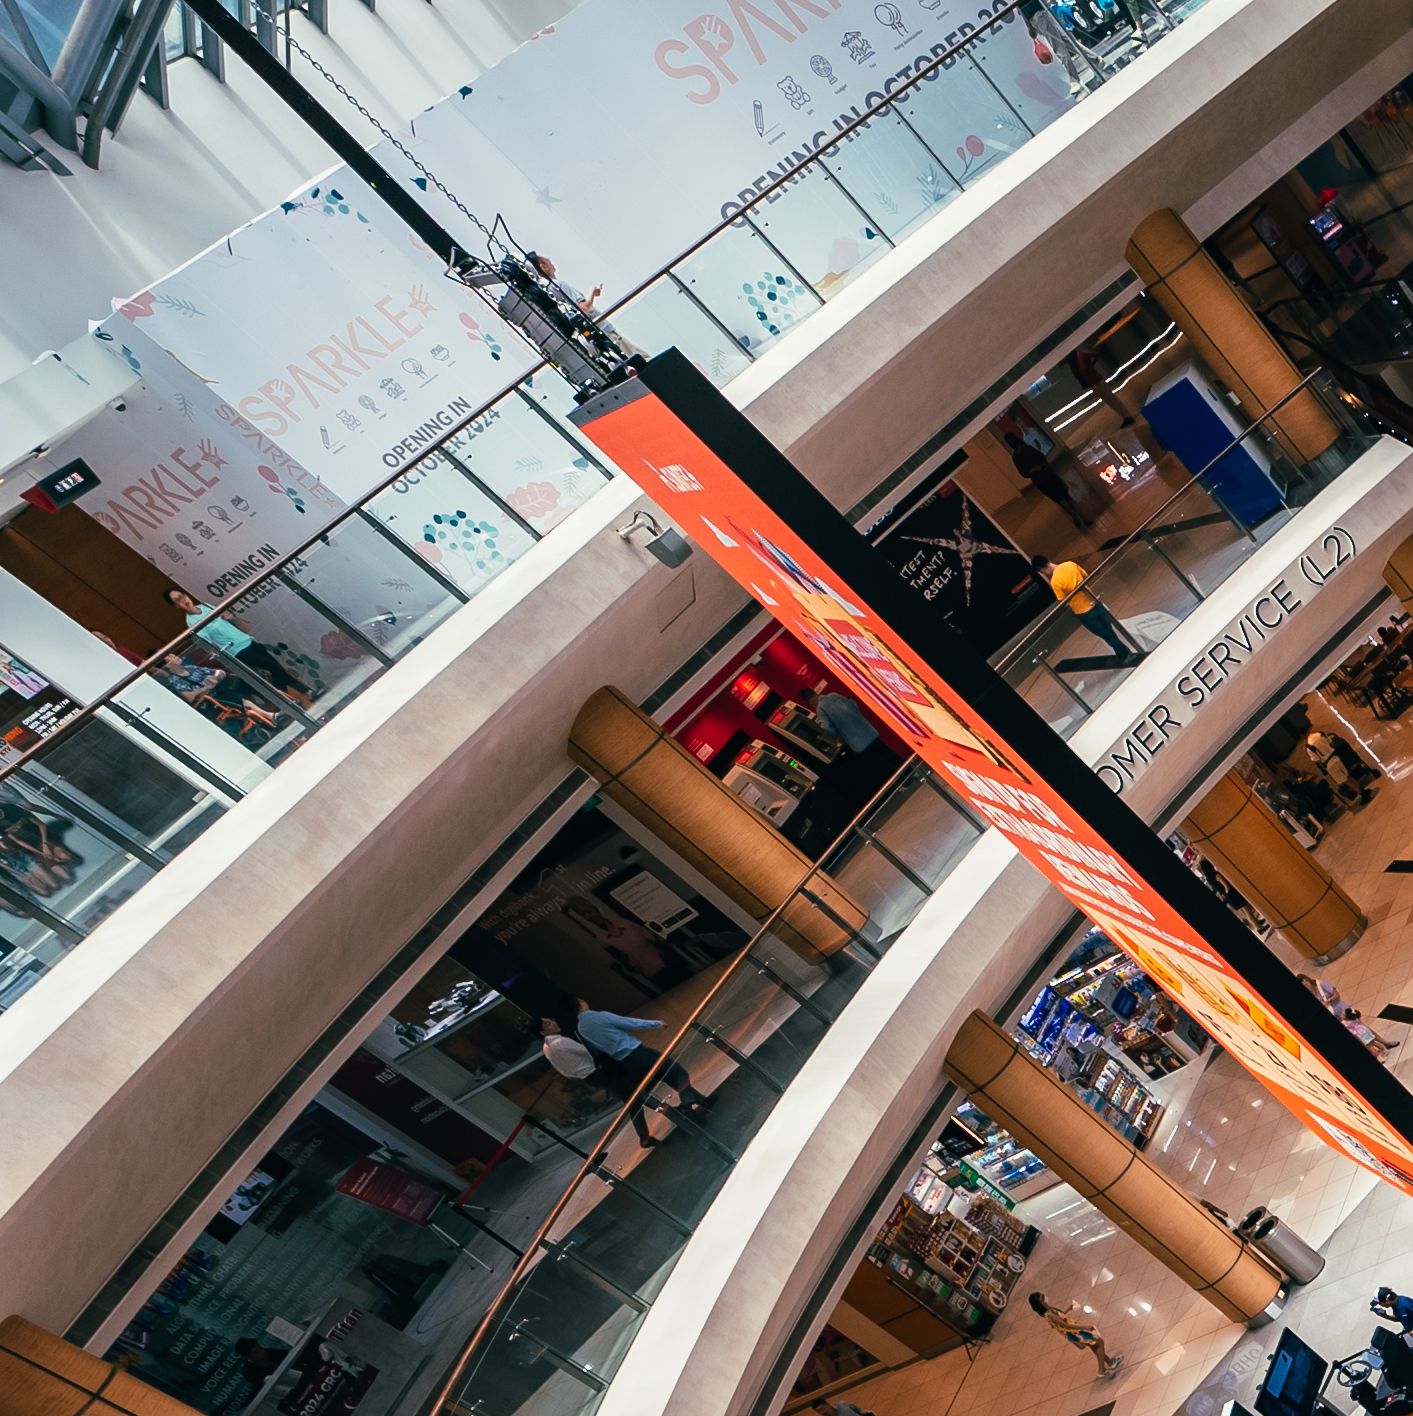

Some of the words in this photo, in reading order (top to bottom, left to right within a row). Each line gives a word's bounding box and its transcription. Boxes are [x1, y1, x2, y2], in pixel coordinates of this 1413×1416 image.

[720, 131, 840, 228] OPENING
[865, 21, 984, 117] OCTOBER
[239, 295, 418, 437] SPARKLE
[214, 403, 333, 501] SPARKLE
[382, 411, 447, 468] OPENING
[441, 395, 473, 428] IN
[391, 434, 463, 496] OCTOBER
[463, 406, 502, 440] 2024
[91, 447, 221, 541] PARKLE
[206, 553, 259, 599] OPENING
[255, 542, 281, 568] IN
[1177, 579, 1302, 707] SERVICE
[1300, 526, 1356, 586] (L2)
[196, 1342, 226, 1375] IMAGE
[326, 1303, 365, 1346] Titan
[200, 1366, 228, 1395] VOICE
[317, 1366, 344, 1394] GRC
